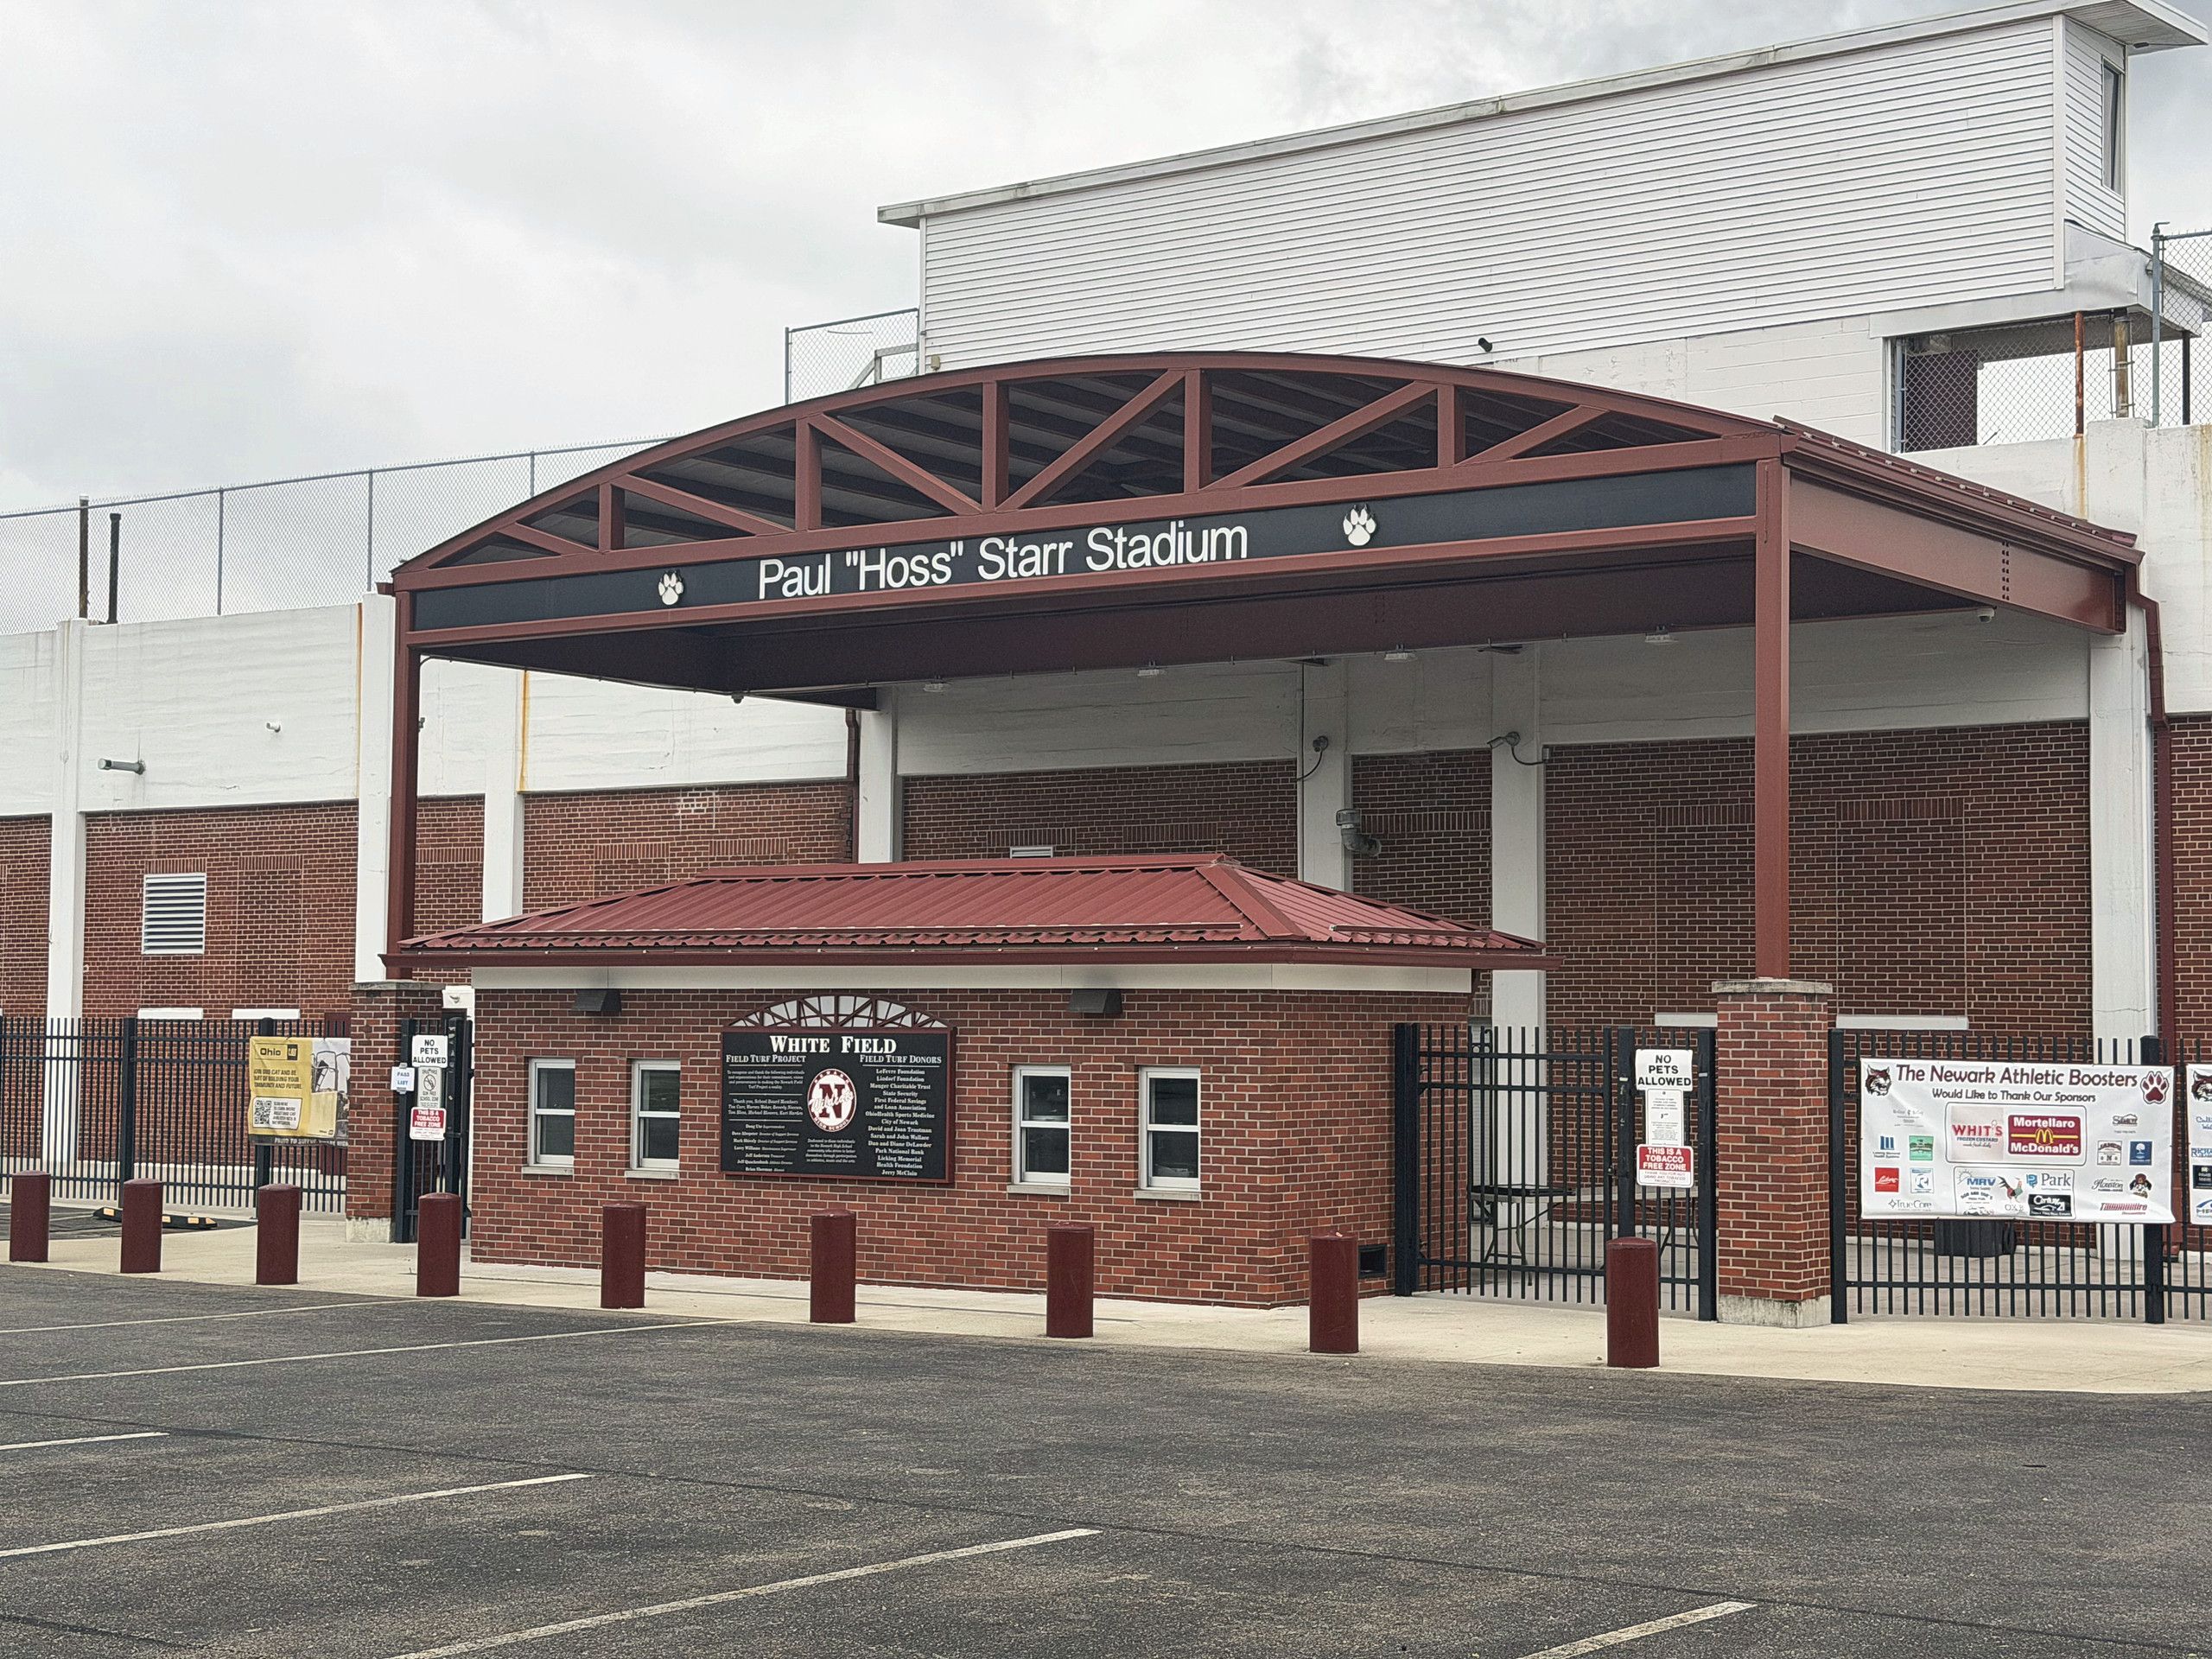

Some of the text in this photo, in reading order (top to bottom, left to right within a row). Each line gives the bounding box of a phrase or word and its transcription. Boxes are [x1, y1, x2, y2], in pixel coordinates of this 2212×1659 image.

[759, 520, 1248, 599] Paul "Hoss" Starr Stadium
[770, 1035, 896, 1053] WHITE FIELD
[1656, 1055, 1671, 1064] NO
[1649, 1065, 1678, 1074] PETS
[1638, 1077, 1691, 1086] ALLOWED
[1896, 1065, 2138, 1087] The Newark Athletic Boosters
[1932, 1088, 2096, 1103] Would Like to Thank Our Sponsors
[829, 1119, 849, 1131] SCHOOL
[2013, 1117, 2075, 1128] Mortellaro
[1952, 1124, 2003, 1136] WHIT'S
[2011, 1143, 2079, 1154] McDonald's
[1645, 1154, 1684, 1163] TOBACCO
[2041, 1173, 2071, 1186] Park
